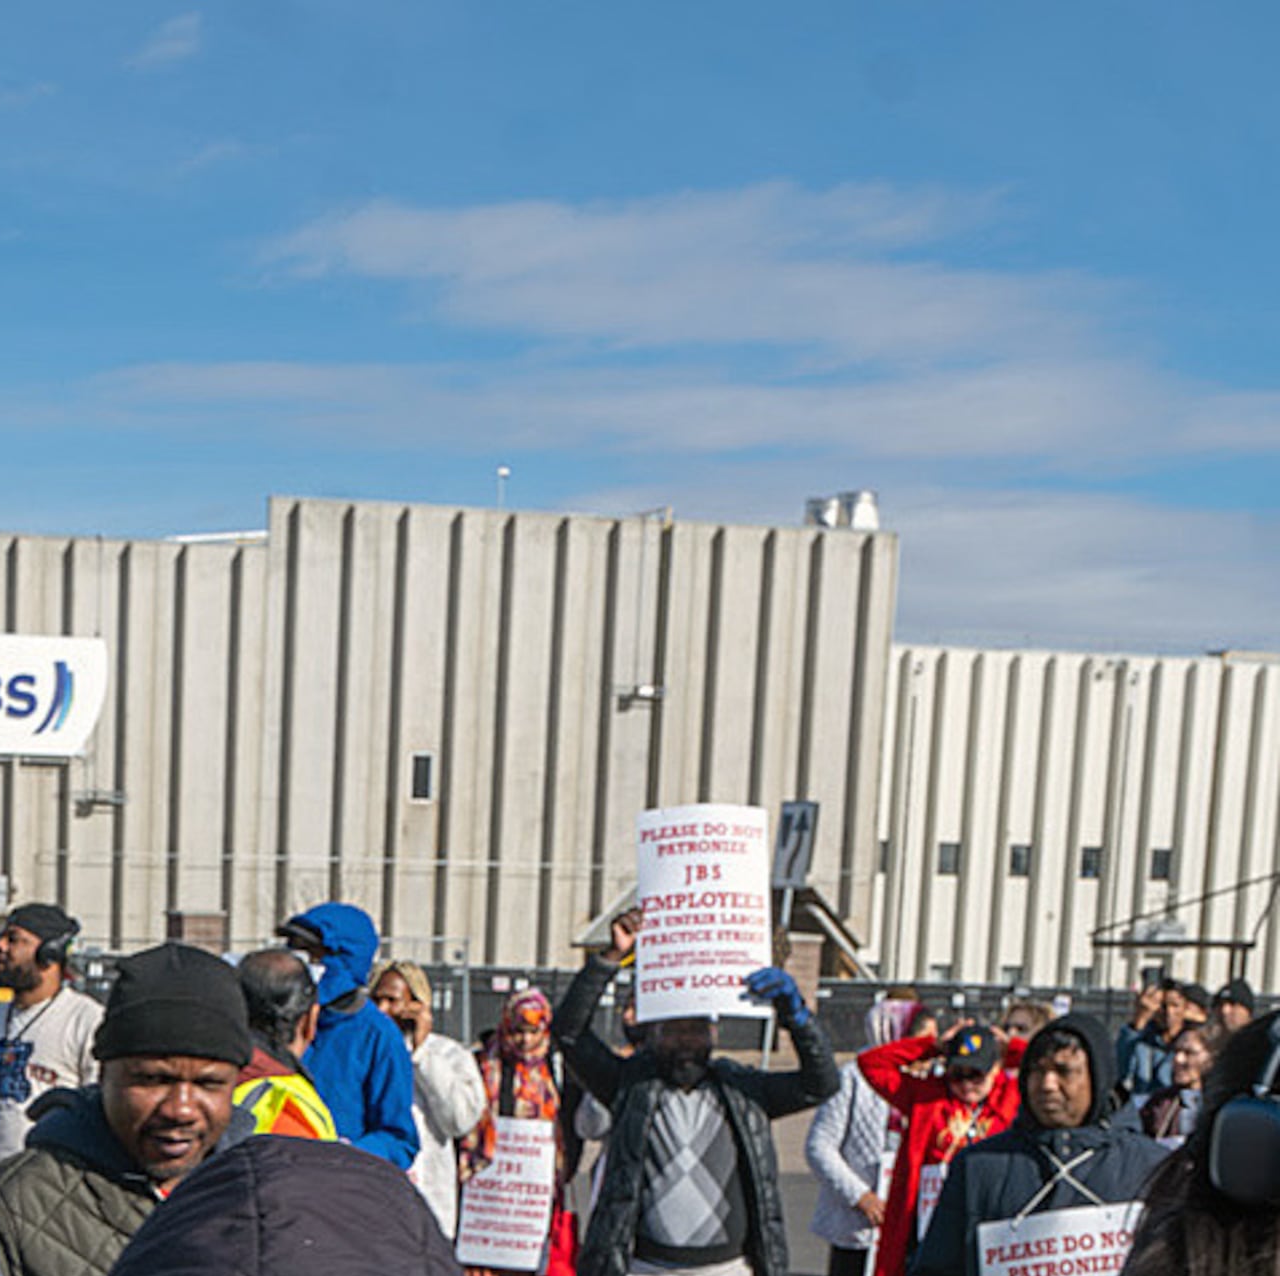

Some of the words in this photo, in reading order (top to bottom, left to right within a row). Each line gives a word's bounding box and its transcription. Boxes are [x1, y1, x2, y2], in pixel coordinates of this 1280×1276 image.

[685, 864, 721, 886] JBS
[986, 1237, 1058, 1265] PLEASE
[1063, 1234, 1095, 1254] DO
[1100, 1231, 1134, 1249] NO
